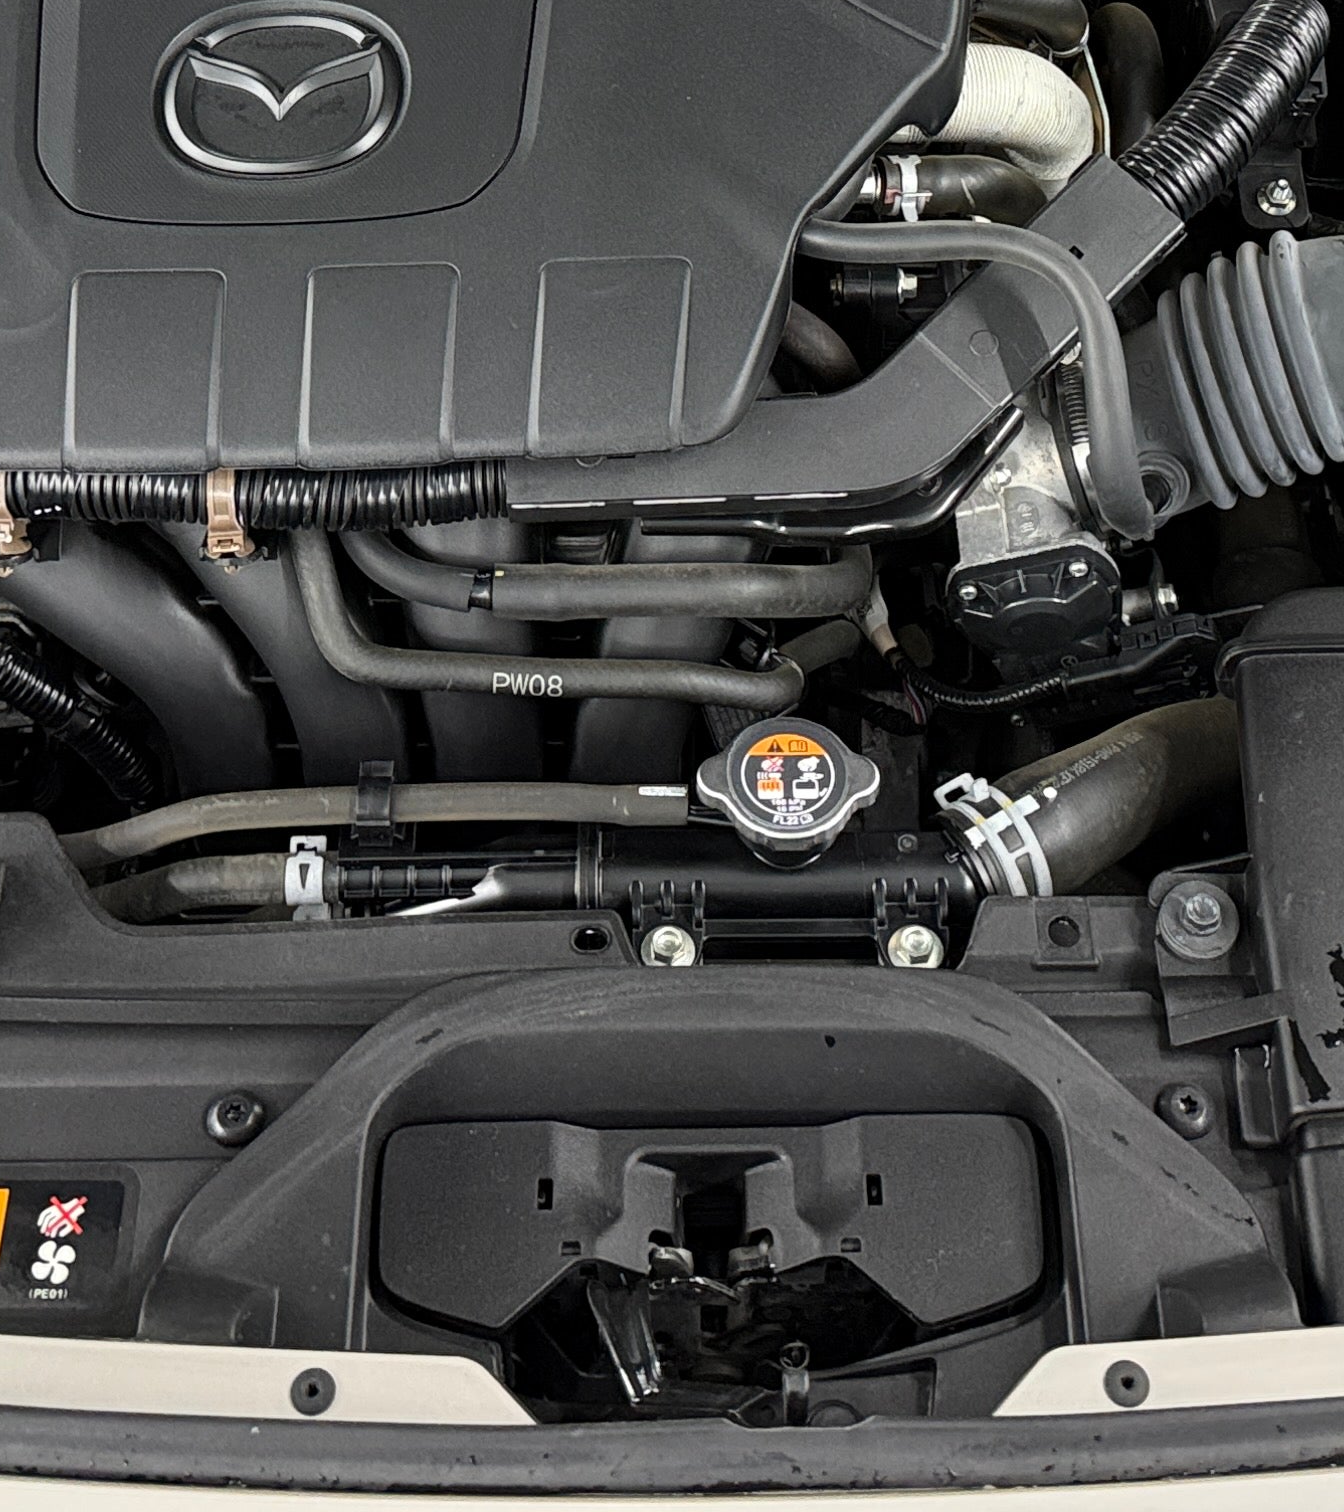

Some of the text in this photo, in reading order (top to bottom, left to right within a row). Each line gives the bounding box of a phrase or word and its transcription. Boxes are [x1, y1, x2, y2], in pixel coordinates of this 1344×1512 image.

[492, 672, 563, 698] PW08
[772, 814, 799, 825] FL22
[28, 1288, 68, 1300] (PE01)
